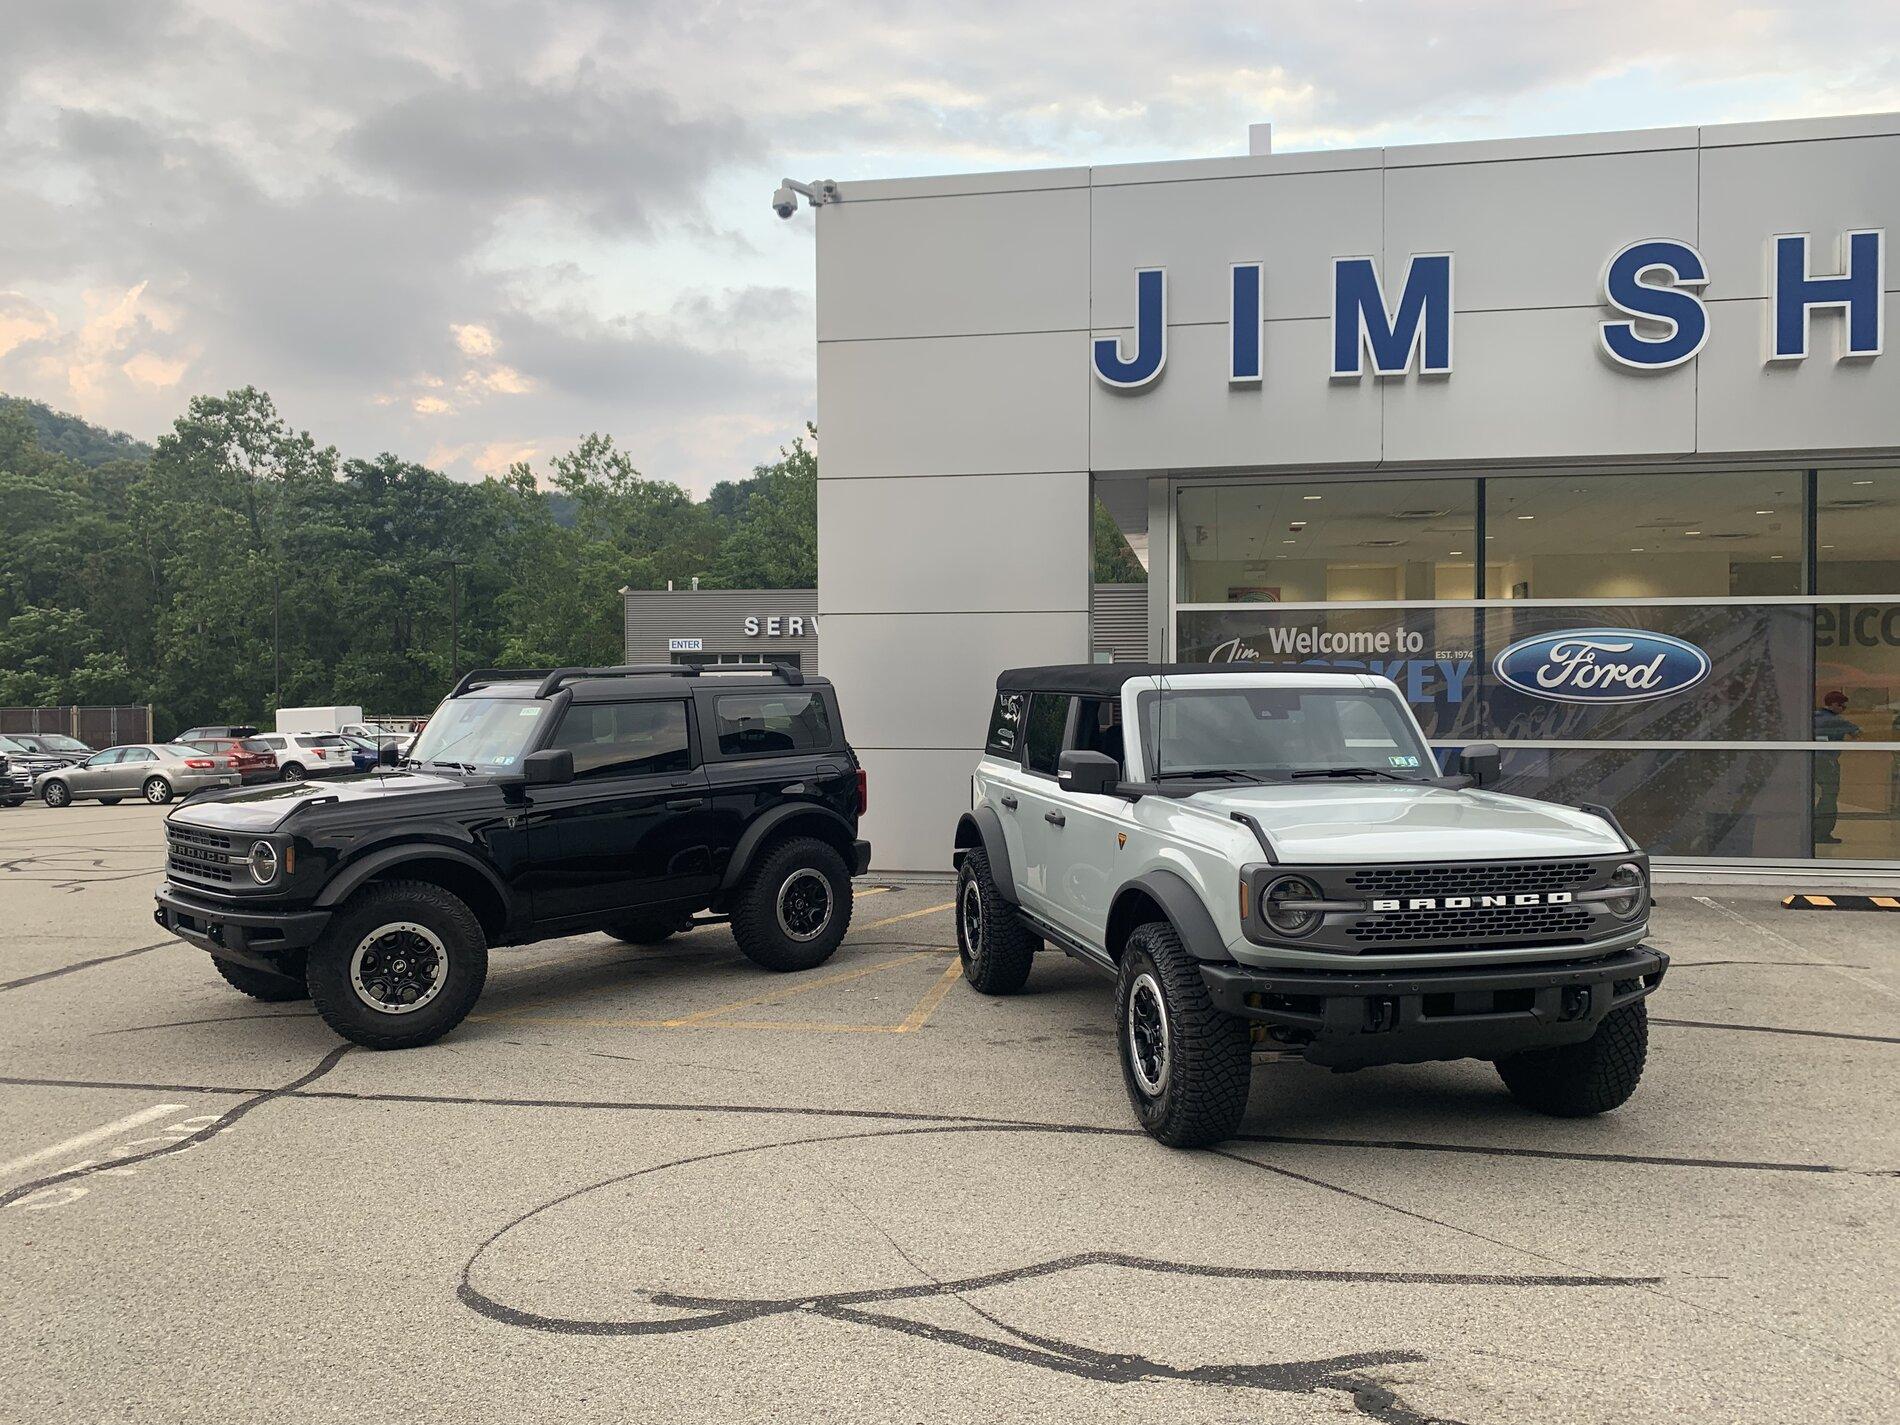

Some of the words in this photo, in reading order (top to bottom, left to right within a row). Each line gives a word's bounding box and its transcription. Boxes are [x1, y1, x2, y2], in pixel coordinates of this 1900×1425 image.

[1091, 251, 1455, 389] JIM
[1598, 227, 1886, 370] SH
[671, 641, 699, 649] ENTER
[1269, 626, 1390, 654] Welcome
[1396, 626, 1423, 653] to
[1435, 651, 1453, 659] EST.
[1455, 650, 1474, 660] 1974
[1536, 640, 1666, 690] Ford
[169, 845, 227, 863] BRONCO
[1373, 892, 1572, 911] BRONCO
